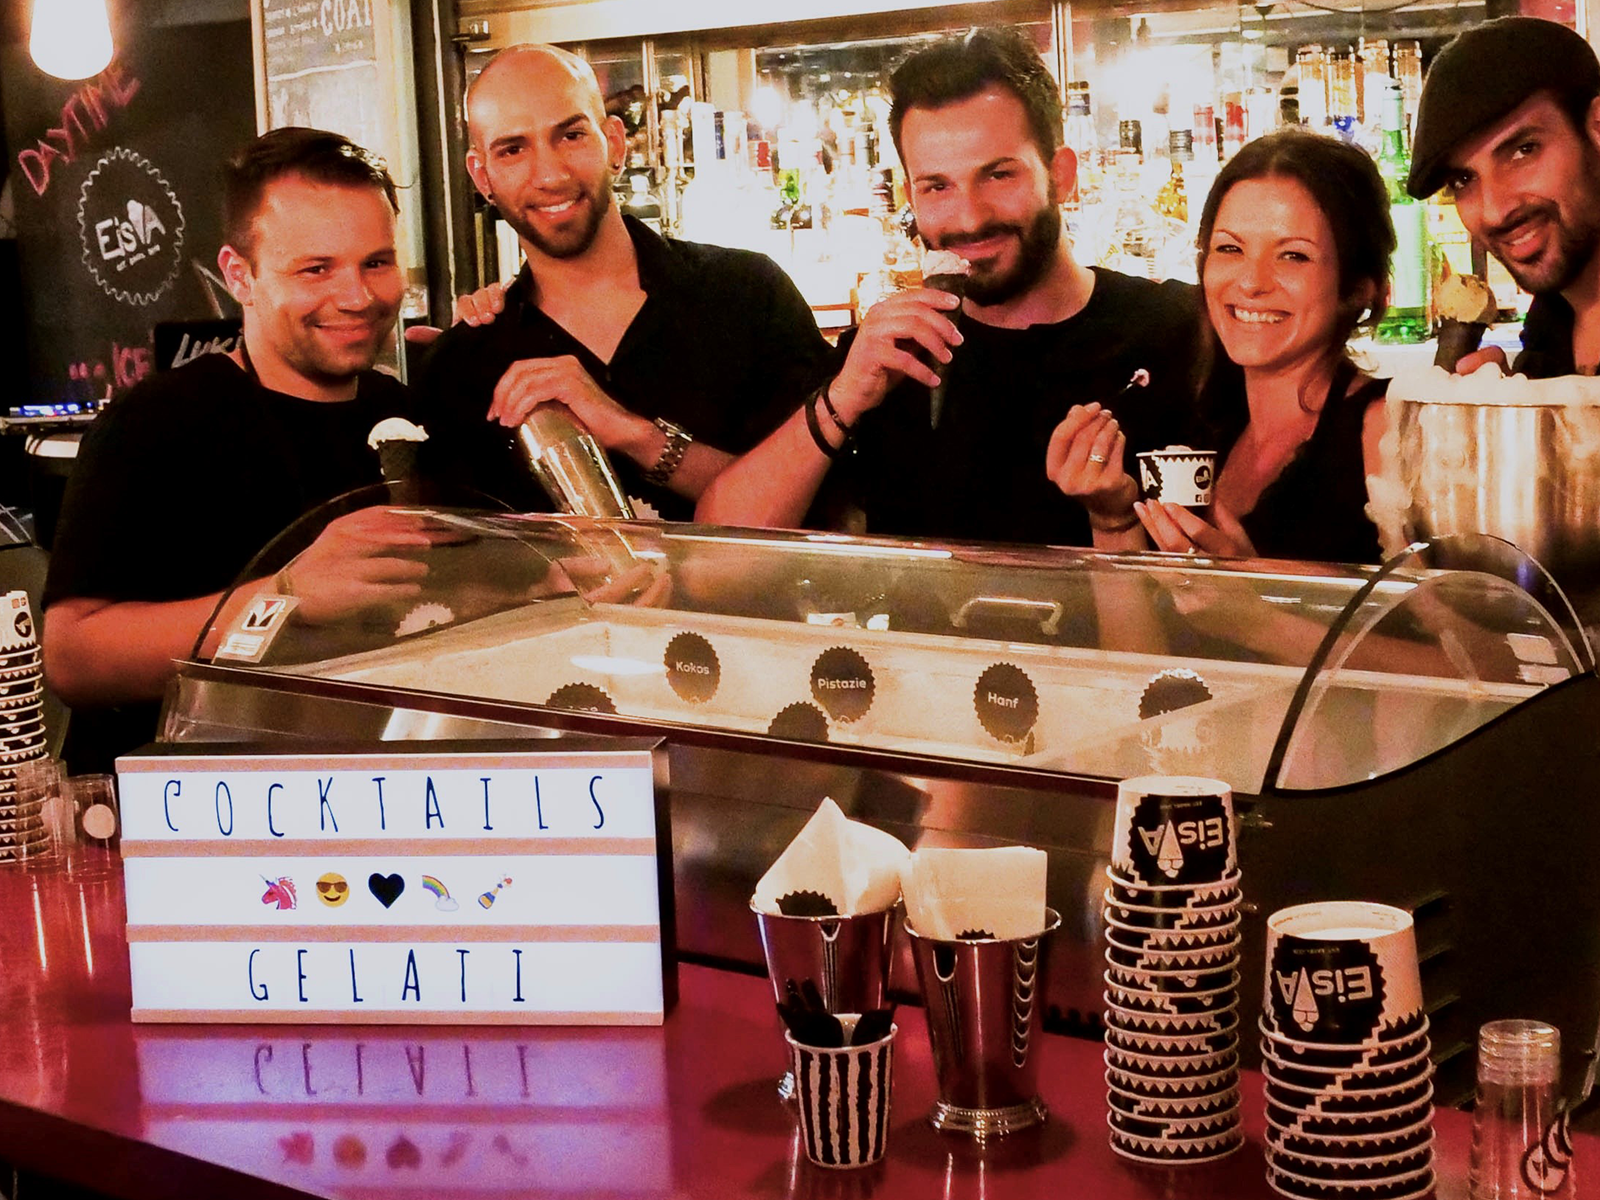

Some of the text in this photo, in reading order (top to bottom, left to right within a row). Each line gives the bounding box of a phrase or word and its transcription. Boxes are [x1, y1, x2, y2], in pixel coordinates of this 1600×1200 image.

[675, 661, 710, 676] Kokos
[817, 676, 867, 691] Pistazie
[987, 691, 1019, 709] Hanf
[164, 775, 606, 838] COCKTAILS
[249, 948, 526, 1003] GELATI
